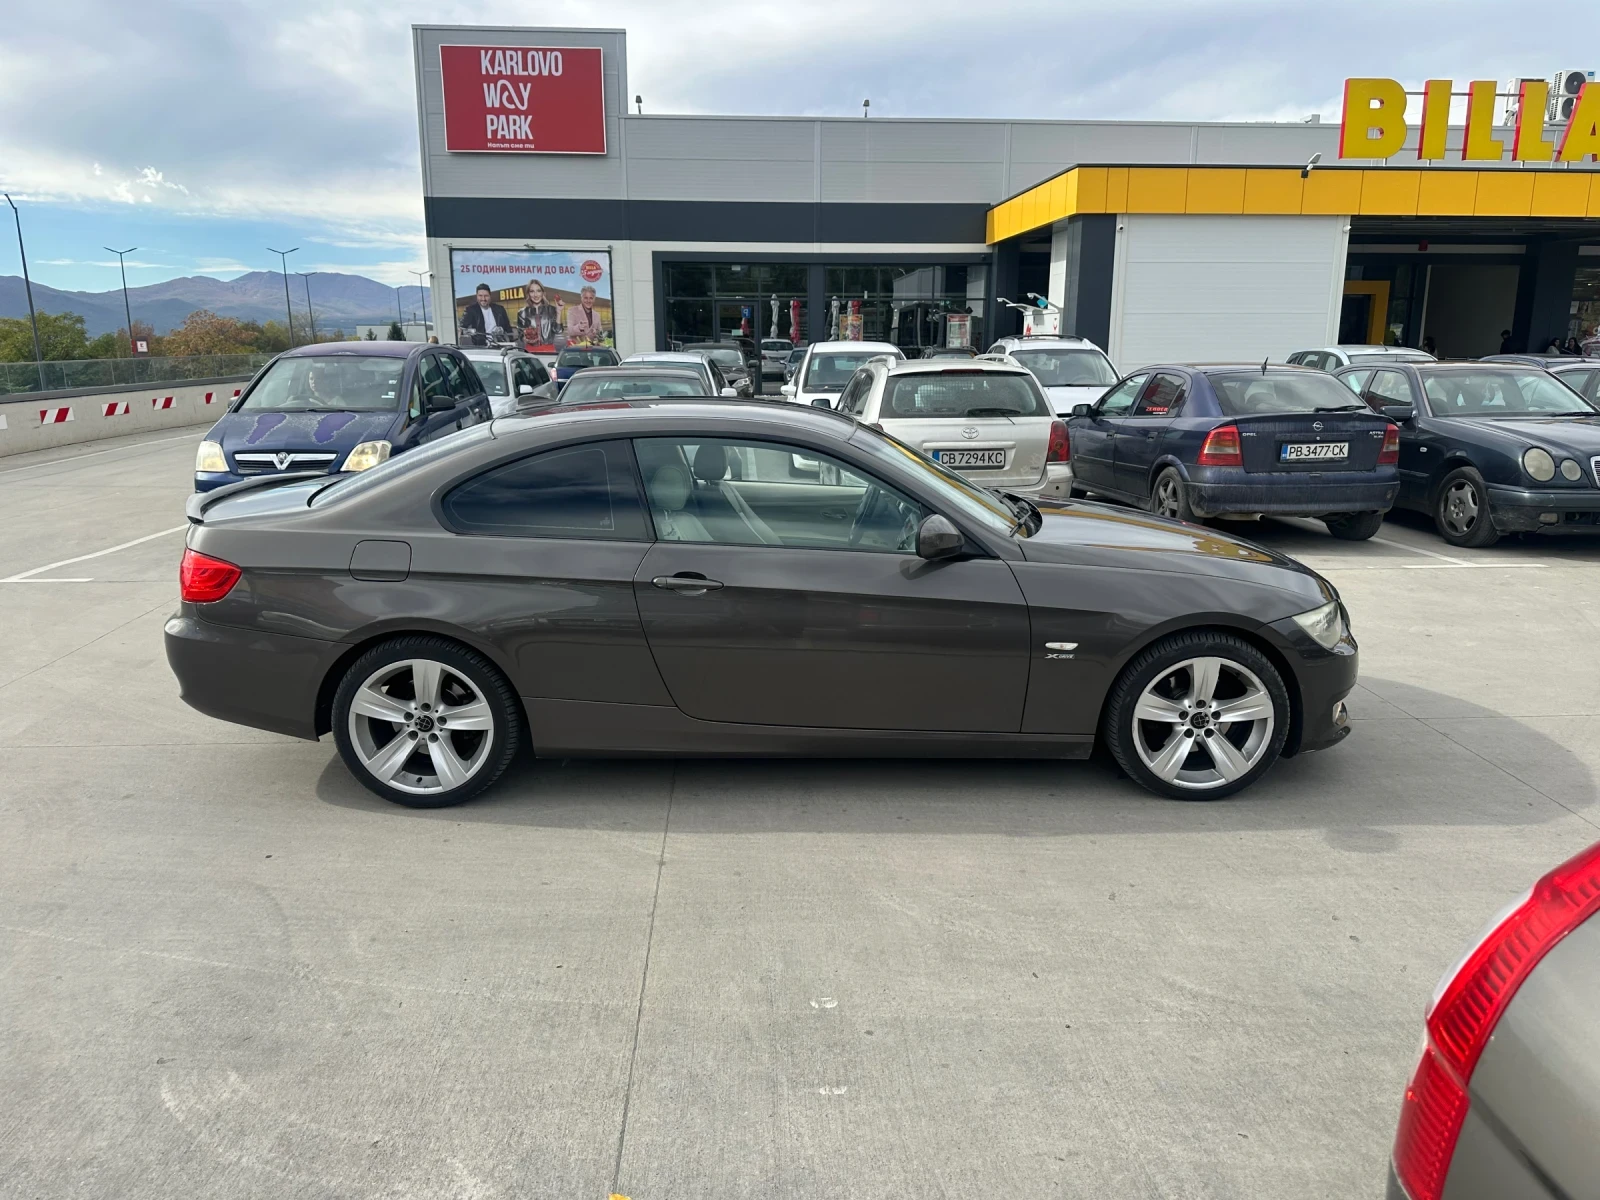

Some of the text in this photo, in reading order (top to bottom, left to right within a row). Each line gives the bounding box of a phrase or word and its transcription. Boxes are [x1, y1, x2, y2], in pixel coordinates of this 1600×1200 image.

[480, 49, 563, 76] KARLOVO
[486, 114, 534, 140] PARK
[460, 264, 575, 275] 25 ГОДИНИ ВИНАГИ ДО ВАС
[500, 287, 525, 301] BILLA
